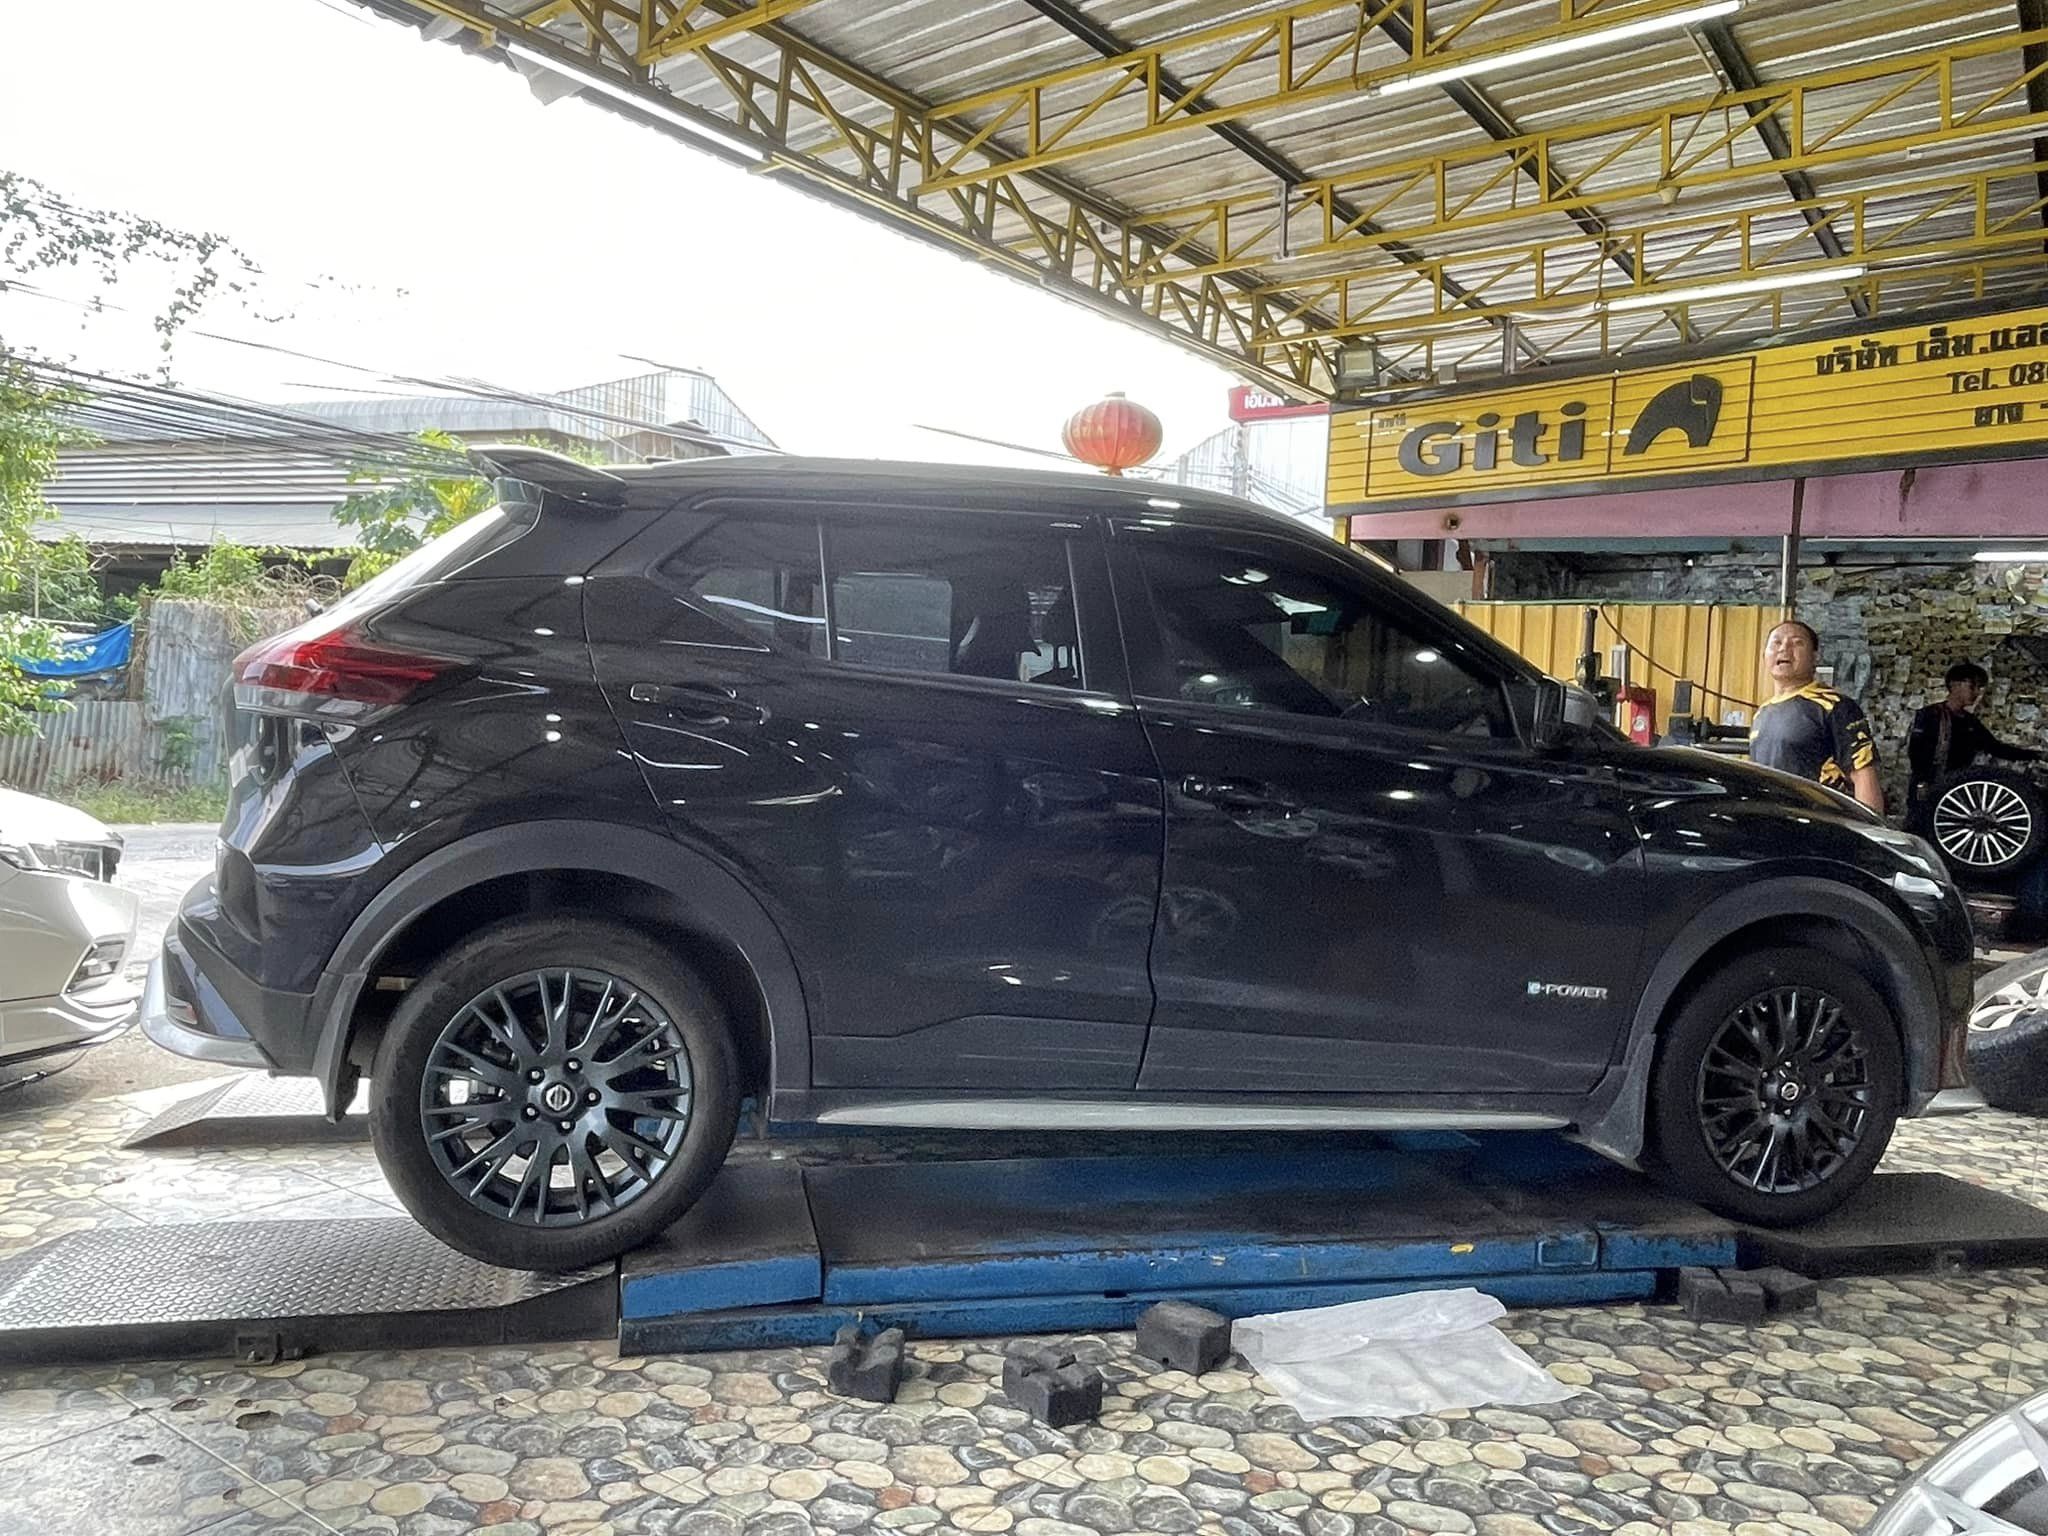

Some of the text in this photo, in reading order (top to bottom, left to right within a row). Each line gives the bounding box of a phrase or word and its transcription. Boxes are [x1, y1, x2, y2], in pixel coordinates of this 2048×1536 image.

[1816, 339, 1898, 375] บริษัท
[1948, 361, 2048, 394] Tel. 08
[1975, 402, 2024, 427] ยาง
[1398, 401, 1587, 477] Giti
[1527, 981, 1608, 1000] e-POWER
